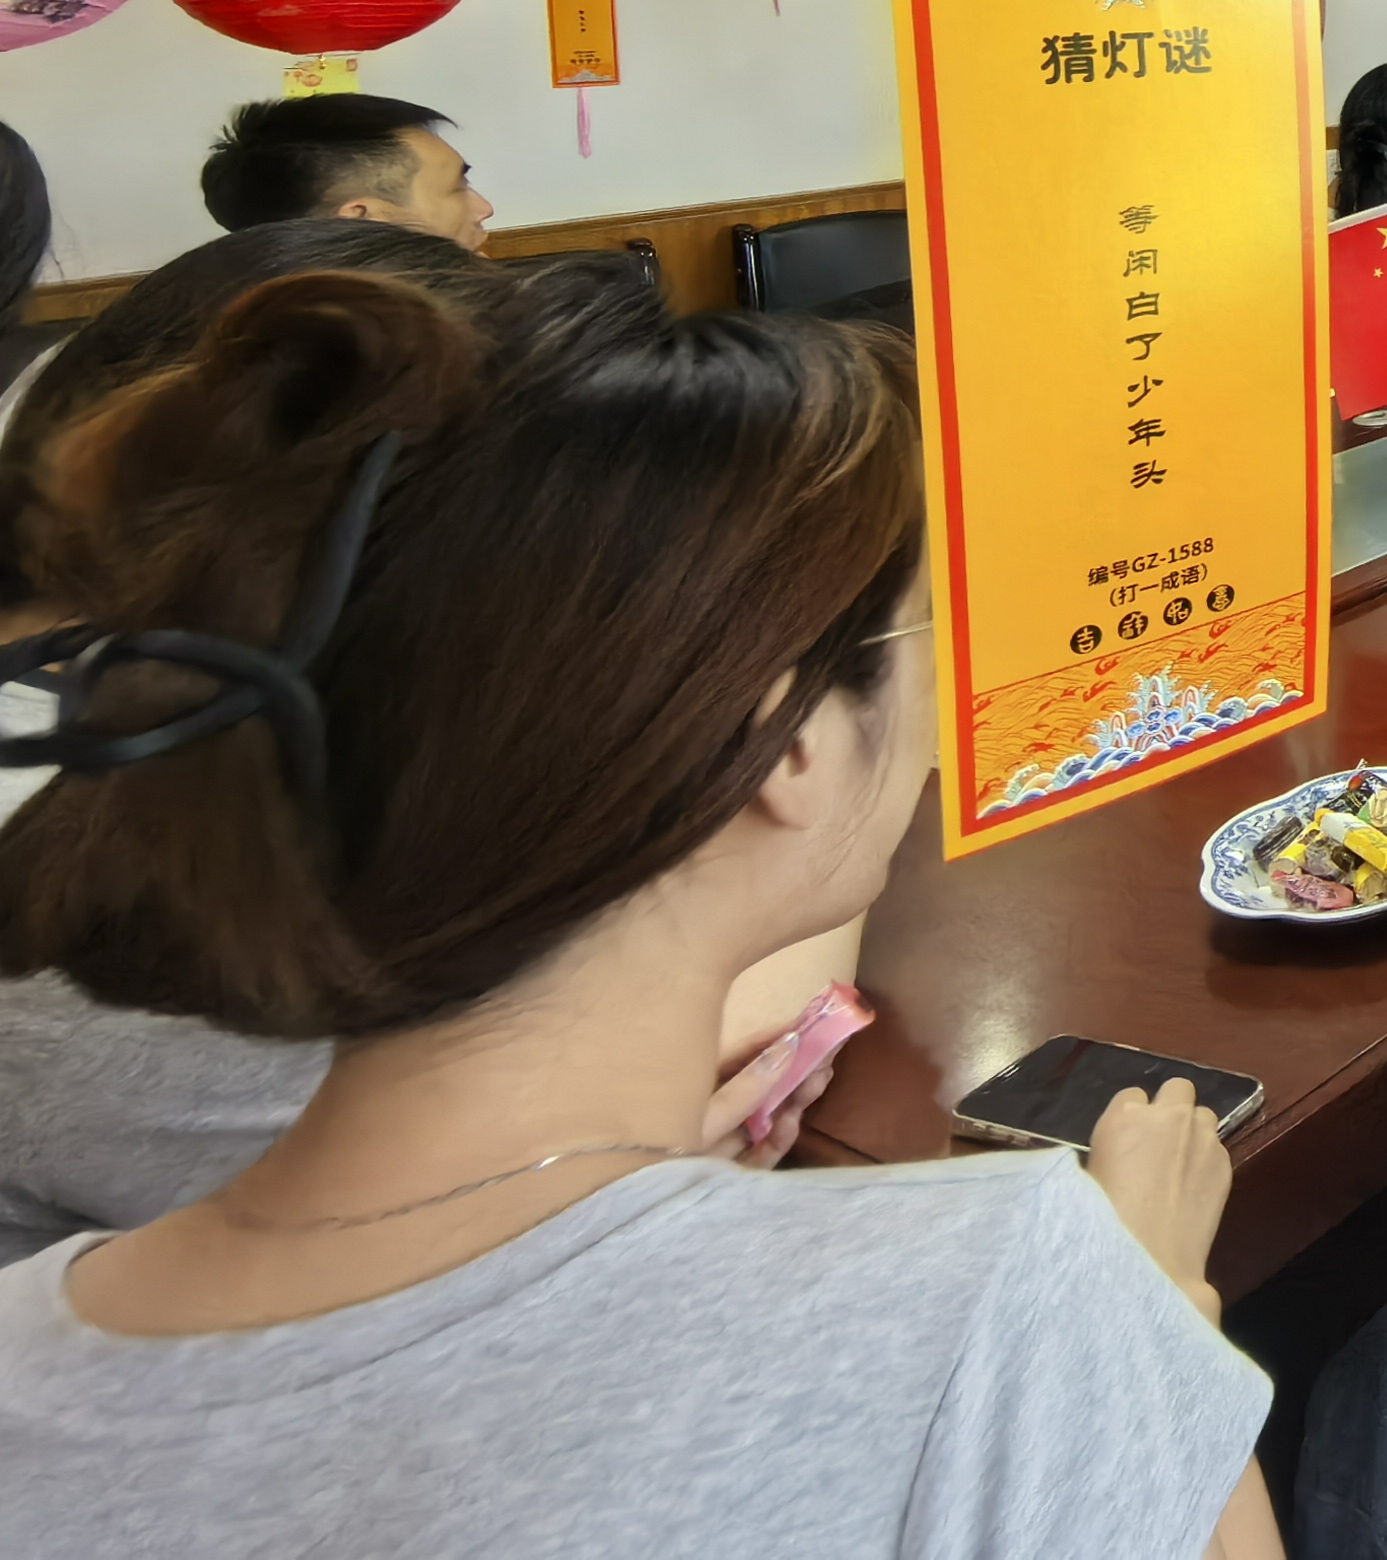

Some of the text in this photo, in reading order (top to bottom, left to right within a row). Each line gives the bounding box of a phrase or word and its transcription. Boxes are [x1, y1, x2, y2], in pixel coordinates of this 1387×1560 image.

[1040, 26, 1212, 85] 猜灯谜
[1118, 205, 1168, 489] 等闲白了少年头
[1088, 537, 1214, 586] 编号GZ-1588
